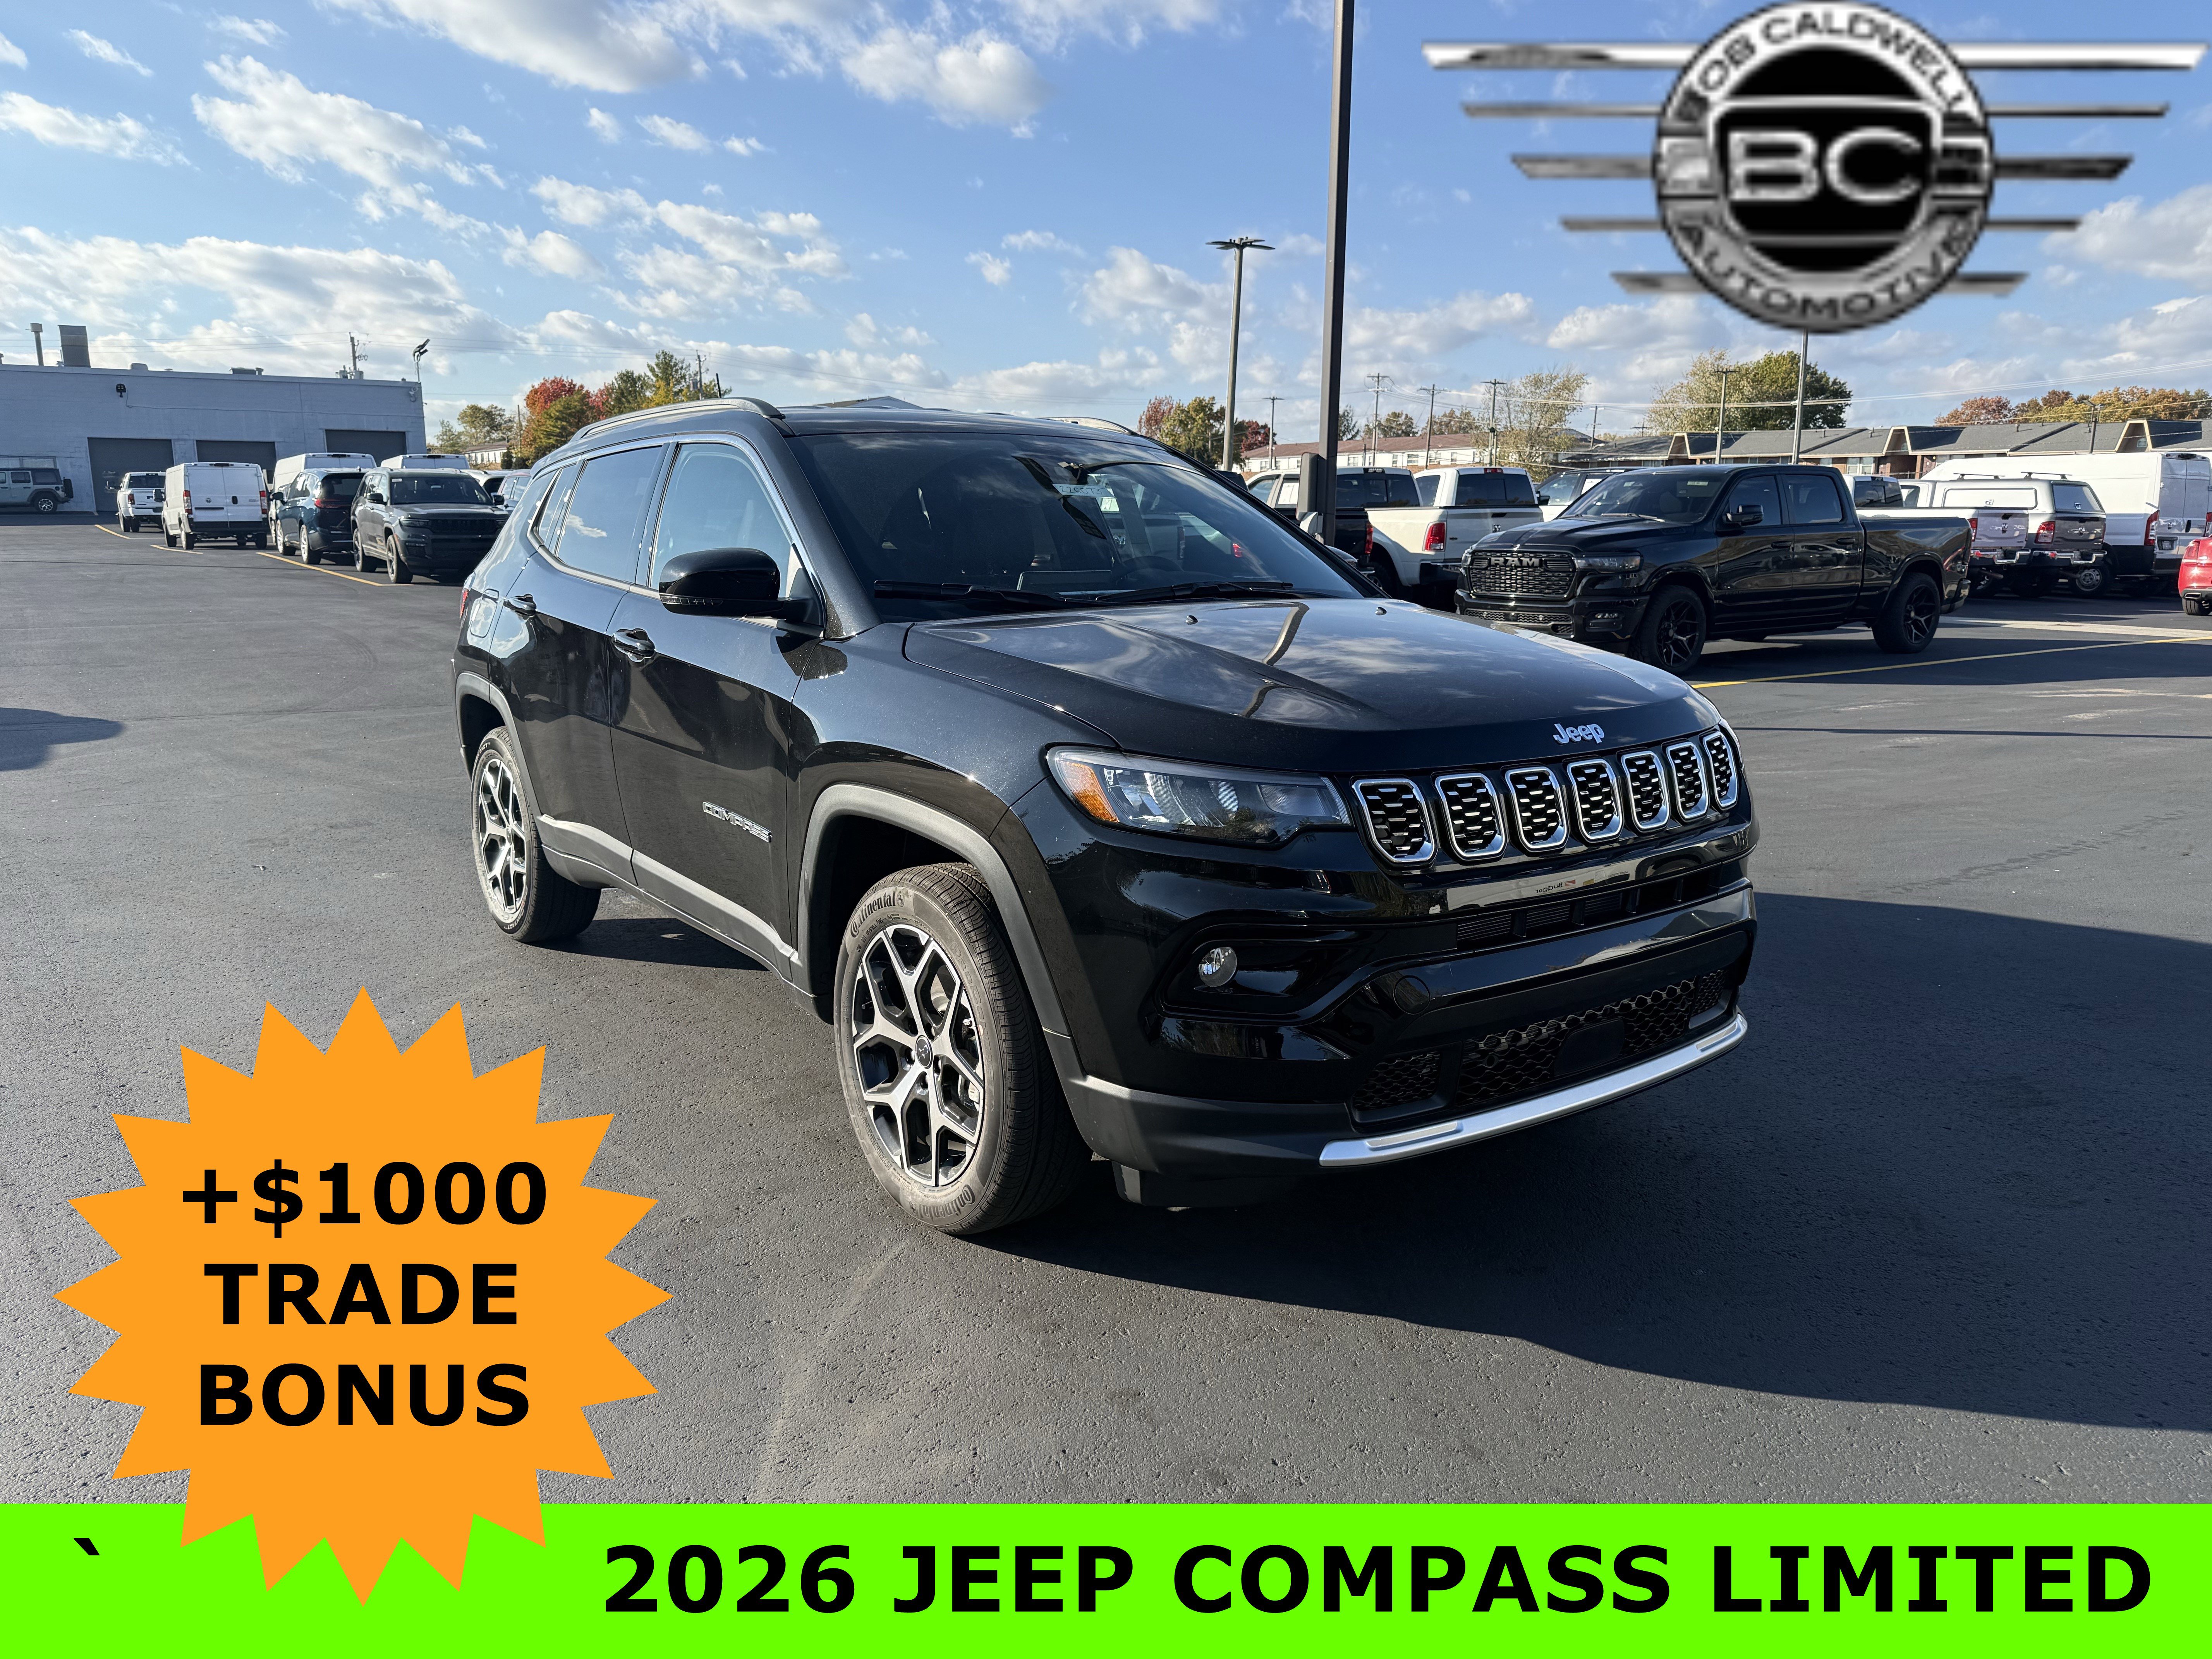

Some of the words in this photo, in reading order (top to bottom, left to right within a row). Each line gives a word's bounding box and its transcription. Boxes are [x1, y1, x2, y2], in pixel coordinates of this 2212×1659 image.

[1491, 557, 1540, 567] RAM
[1553, 723, 1605, 744] Jeep
[702, 802, 773, 843] COMPASS
[850, 891, 896, 938] Continental
